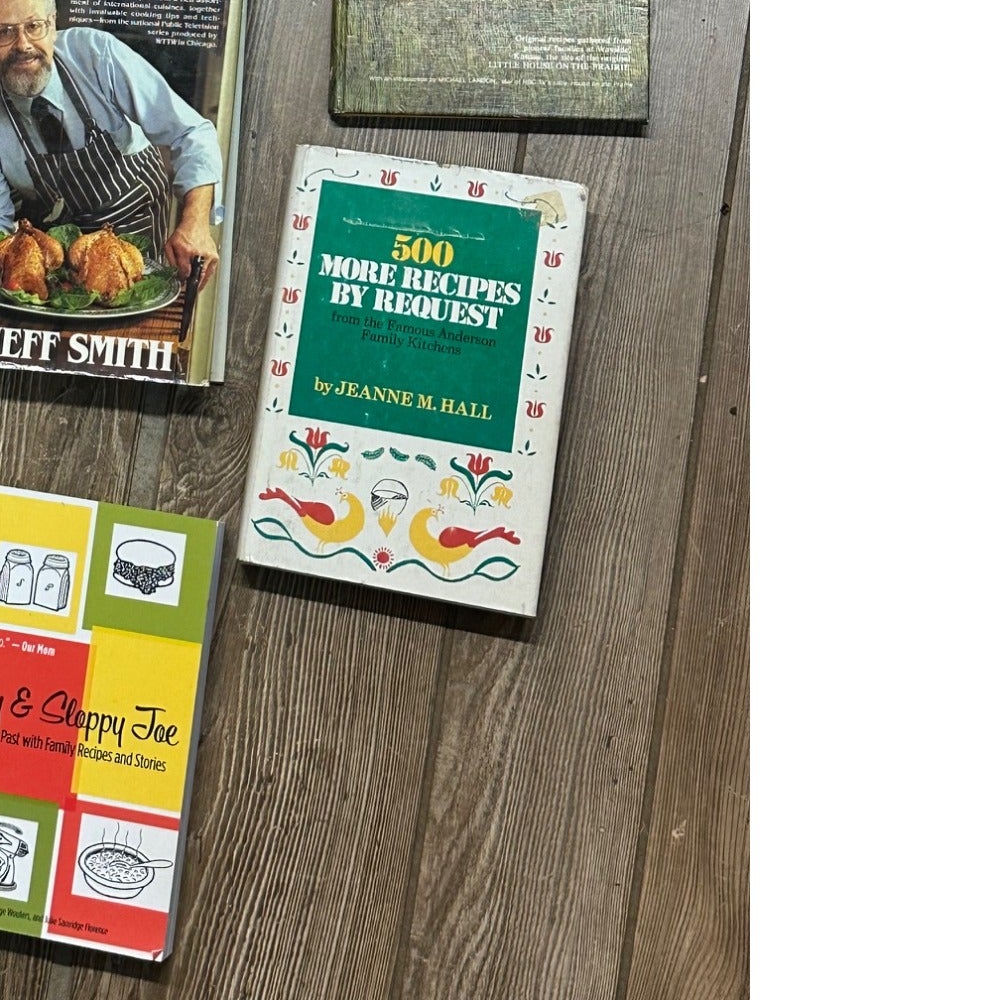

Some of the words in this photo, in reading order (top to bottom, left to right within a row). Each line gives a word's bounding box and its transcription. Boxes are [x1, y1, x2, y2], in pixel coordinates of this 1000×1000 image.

[92, 0, 101, 7] of
[165, 12, 180, 20] tips
[117, 17, 130, 26] the
[207, 32, 218, 40] by
[489, 61, 521, 69] LITTLE
[523, 61, 552, 70] HOUSE
[555, 62, 569, 70] ON
[391, 233, 455, 267] 500
[318, 253, 397, 287] MORE
[406, 267, 522, 306] RECIPES
[329, 281, 369, 308] BY
[372, 288, 504, 330] REQUEST
[331, 311, 360, 326] from
[363, 315, 384, 329] the
[387, 319, 436, 337] Famous
[438, 328, 497, 348] Anderson
[361, 329, 405, 348] Family
[407, 336, 462, 355] Kitchens
[67, 333, 176, 371] SMITH
[314, 376, 335, 396] by
[334, 381, 414, 407] JEANNE
[416, 394, 437, 411] M.
[440, 398, 493, 420] HALL
[21, 641, 36, 653] Our
[36, 644, 56, 657] Mom
[10, 687, 34, 718] &
[39, 690, 126, 747] Sloppy
[131, 706, 180, 747] Joe
[0, 729, 20, 746] Past
[22, 734, 43, 750] with
[44, 737, 76, 757] Family
[77, 743, 113, 762] Recipes
[114, 750, 133, 766] and
[134, 753, 167, 773] Stories
